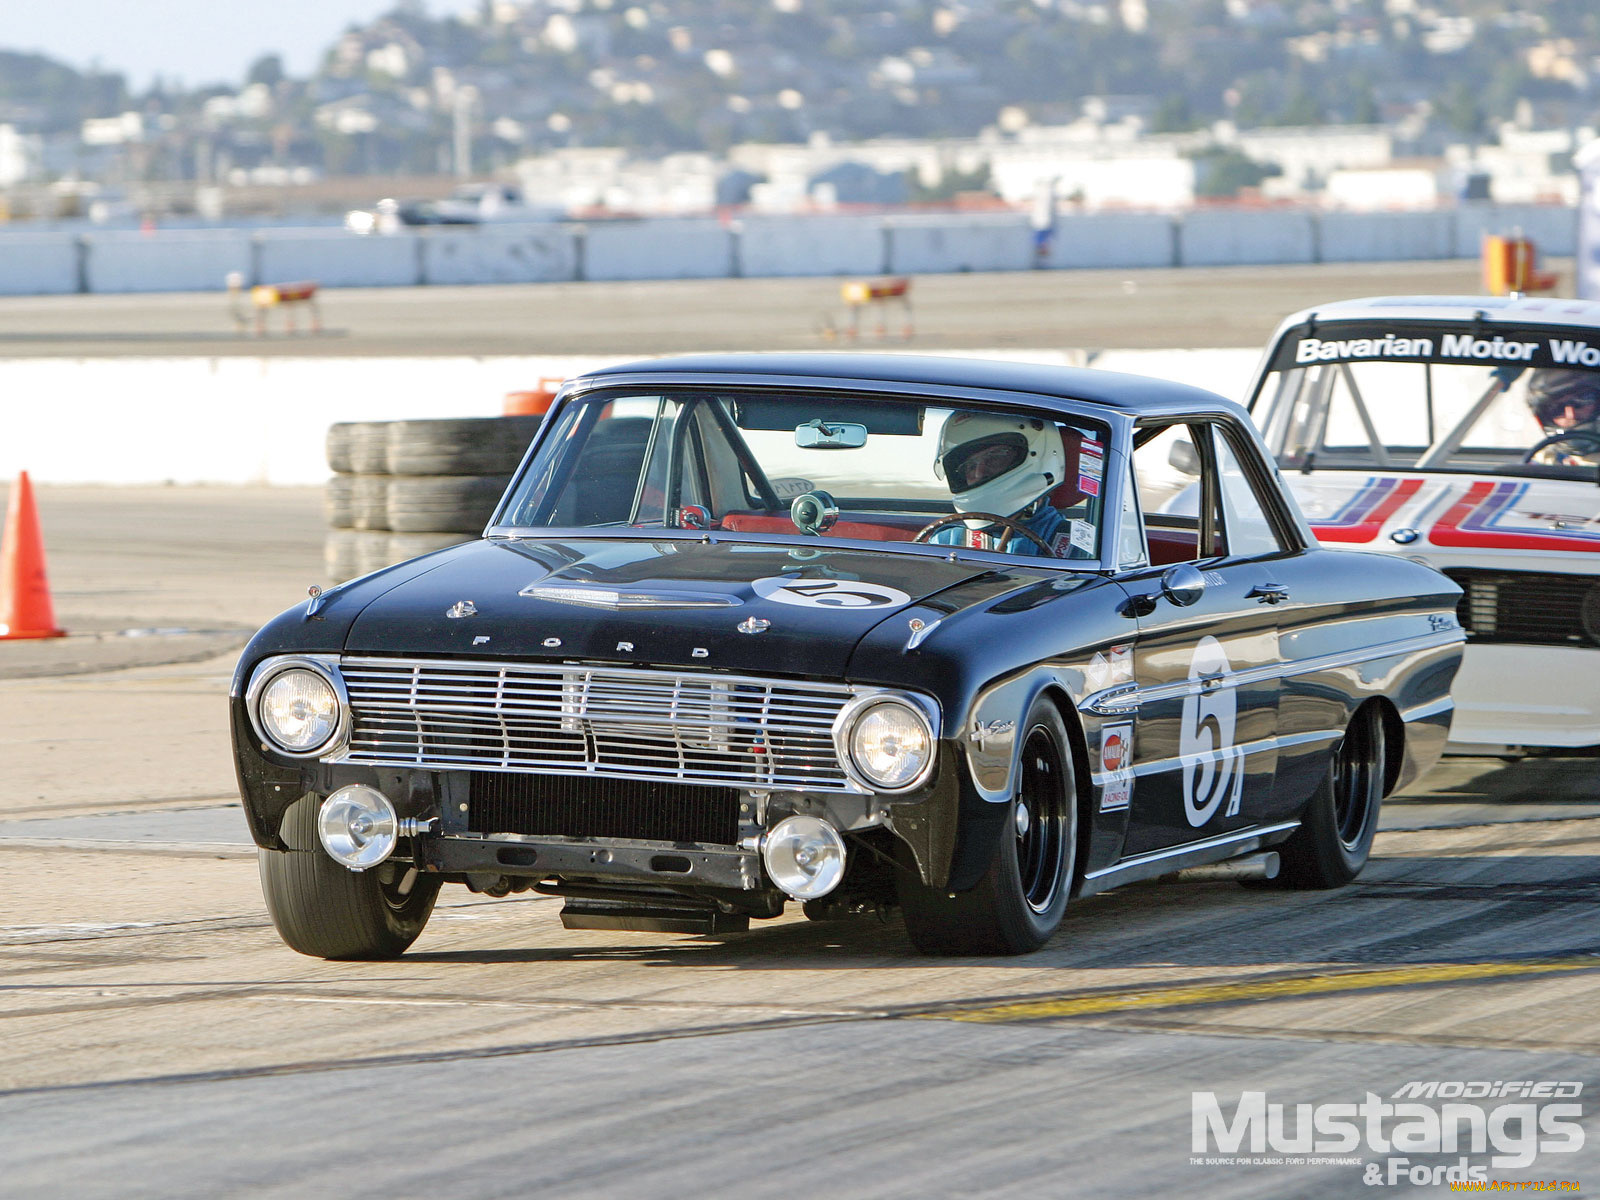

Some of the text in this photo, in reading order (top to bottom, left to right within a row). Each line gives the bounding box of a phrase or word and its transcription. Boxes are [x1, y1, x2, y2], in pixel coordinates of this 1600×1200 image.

[1295, 334, 1600, 367] Bavarian Motor Wo
[777, 582, 893, 606] 5
[472, 635, 710, 658] FORD
[1191, 664, 1222, 811] 5
